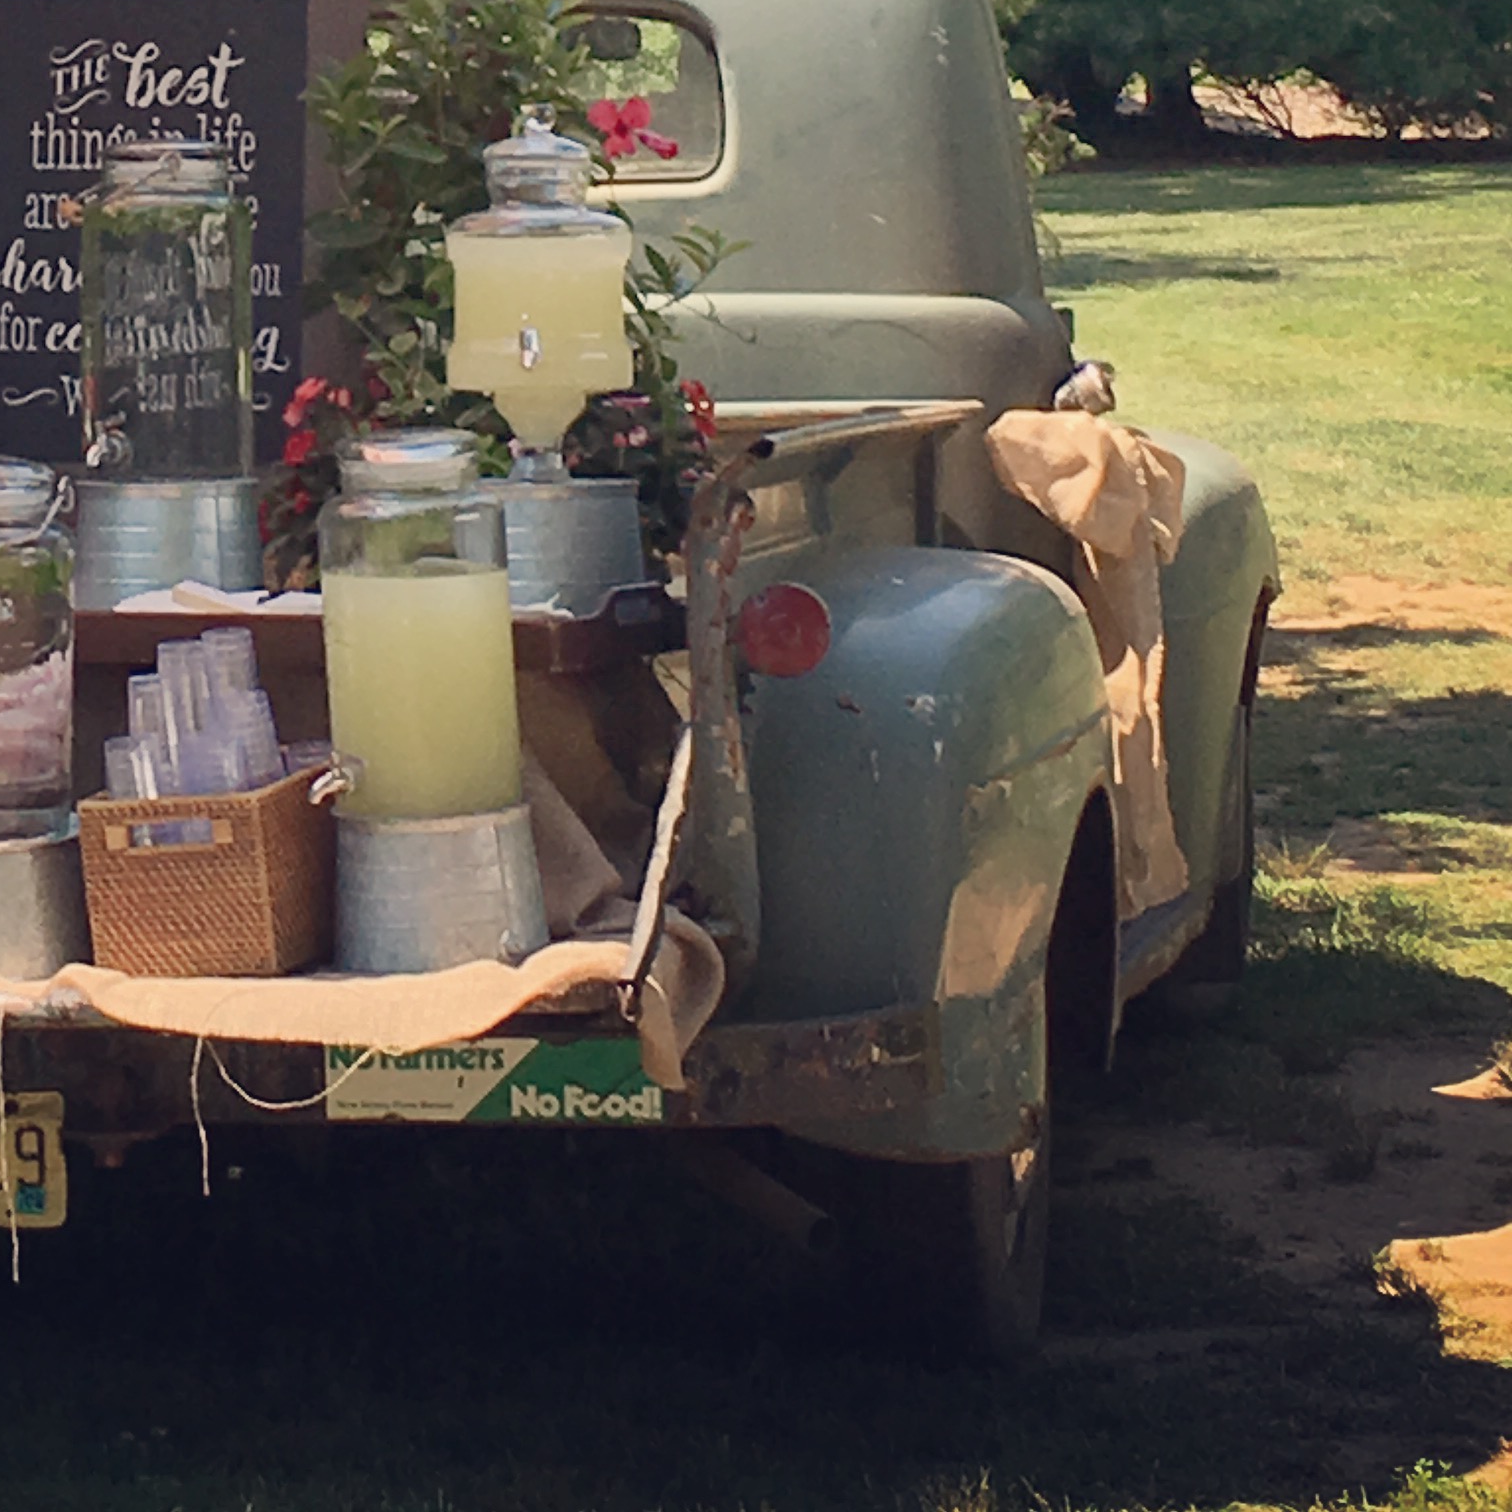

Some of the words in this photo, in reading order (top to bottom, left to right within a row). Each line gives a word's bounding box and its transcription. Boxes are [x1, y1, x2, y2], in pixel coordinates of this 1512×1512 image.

[112, 41, 245, 109] best
[29, 112, 137, 171] thin
[249, 264, 282, 297] ou
[510, 1084, 560, 1119] No
[563, 1084, 662, 1120] Food!
